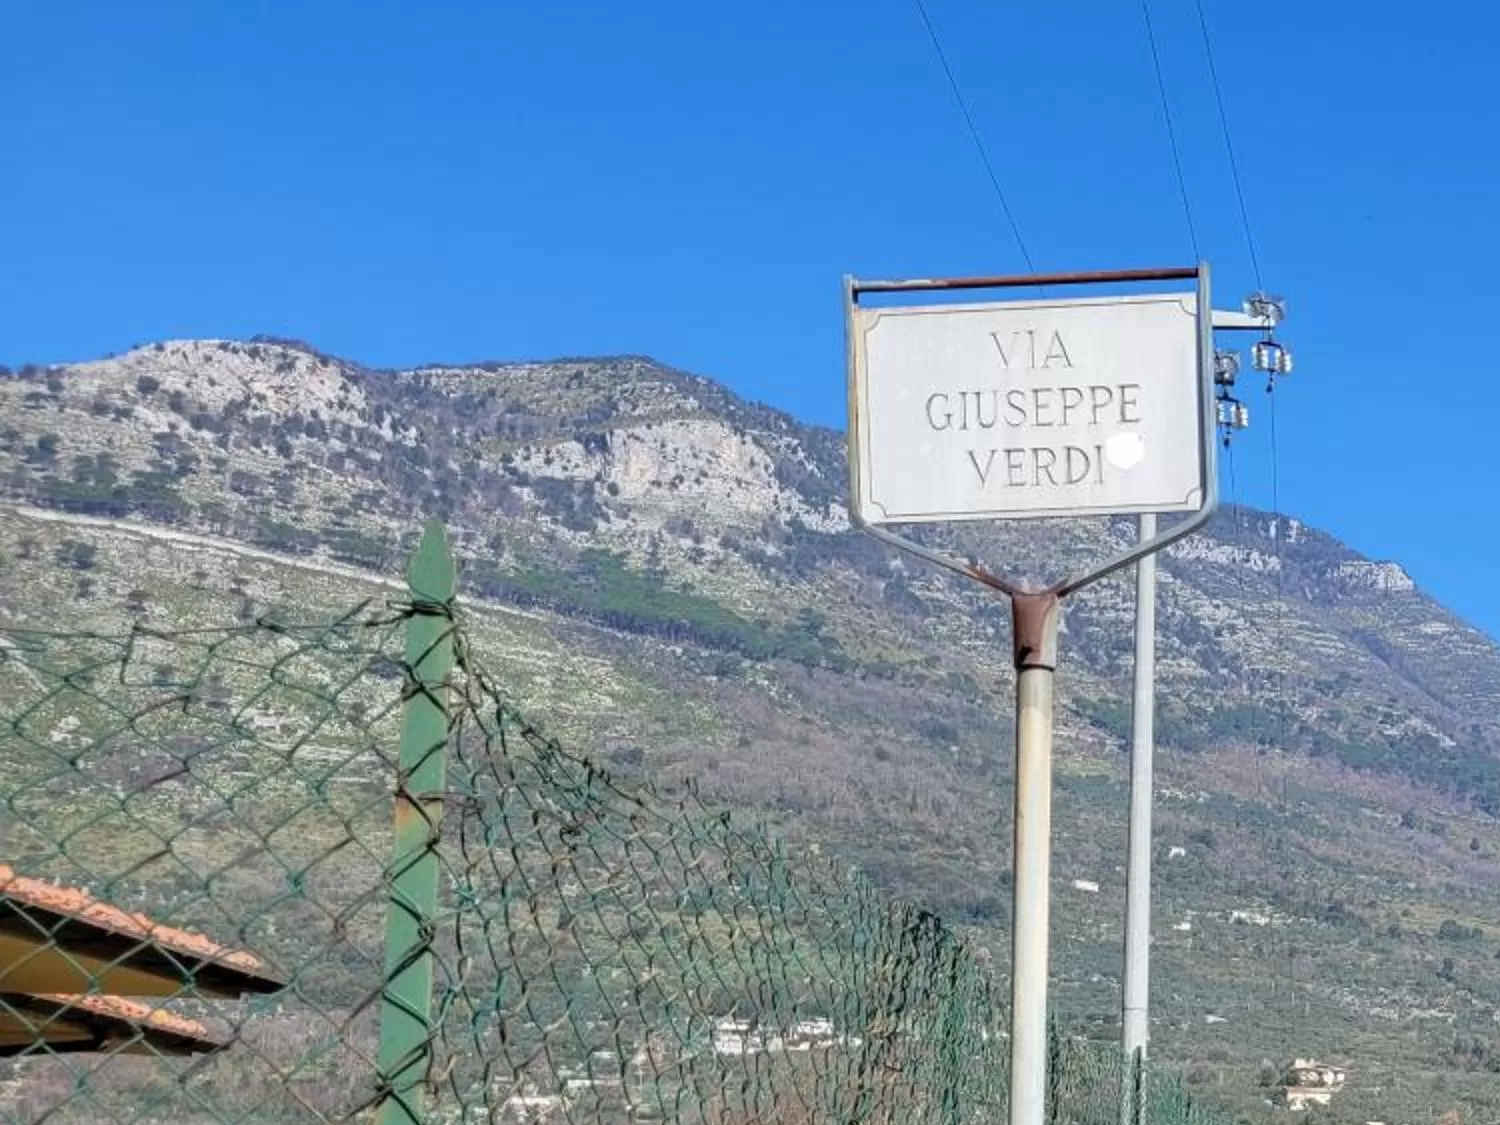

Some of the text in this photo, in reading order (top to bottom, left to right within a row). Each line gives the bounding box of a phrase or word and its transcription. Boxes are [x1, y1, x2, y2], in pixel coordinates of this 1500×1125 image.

[988, 329, 1074, 369] VIA
[925, 384, 1142, 431] GIUSEPPE
[968, 444, 1105, 488] VERDI
